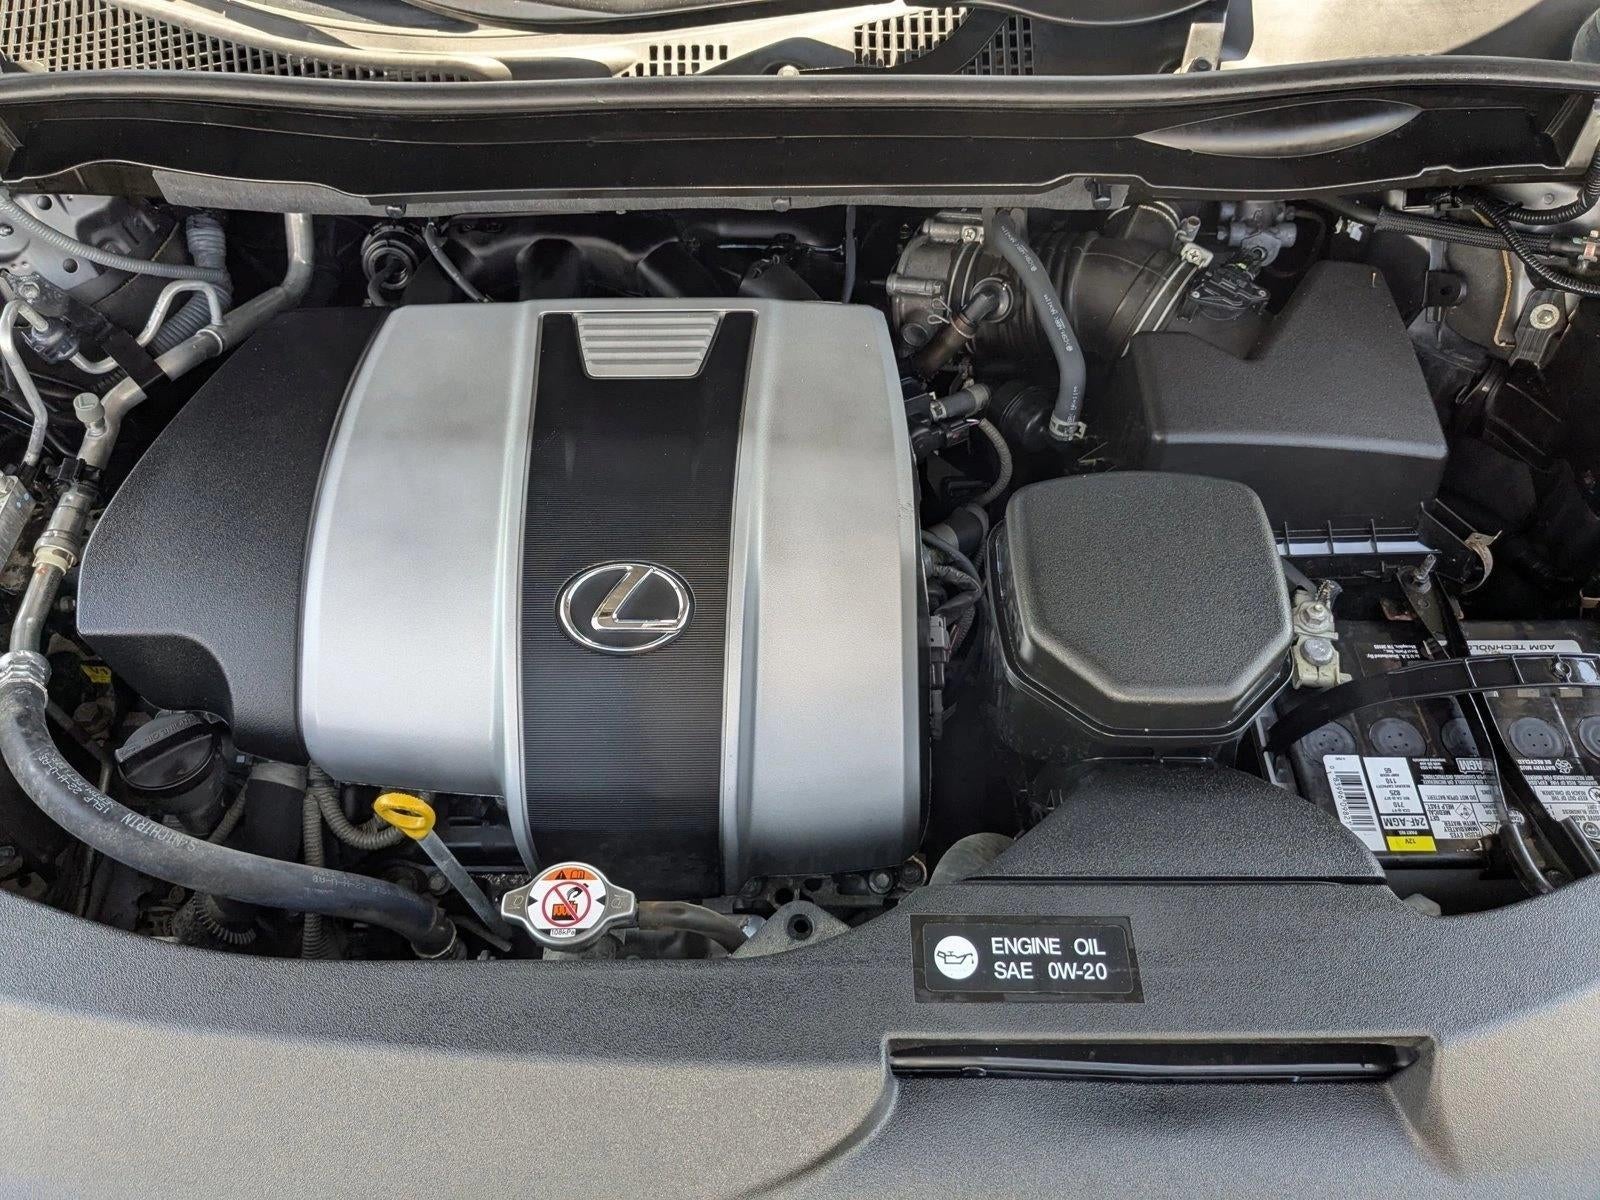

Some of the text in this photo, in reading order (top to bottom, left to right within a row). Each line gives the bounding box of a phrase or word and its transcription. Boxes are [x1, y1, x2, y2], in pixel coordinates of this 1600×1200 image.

[1459, 760, 1484, 770] AGM
[1382, 817, 1426, 827] 24F-AGM
[991, 938, 1106, 956] ENGINE OIL
[994, 962, 1108, 980] SAE 0W-20
